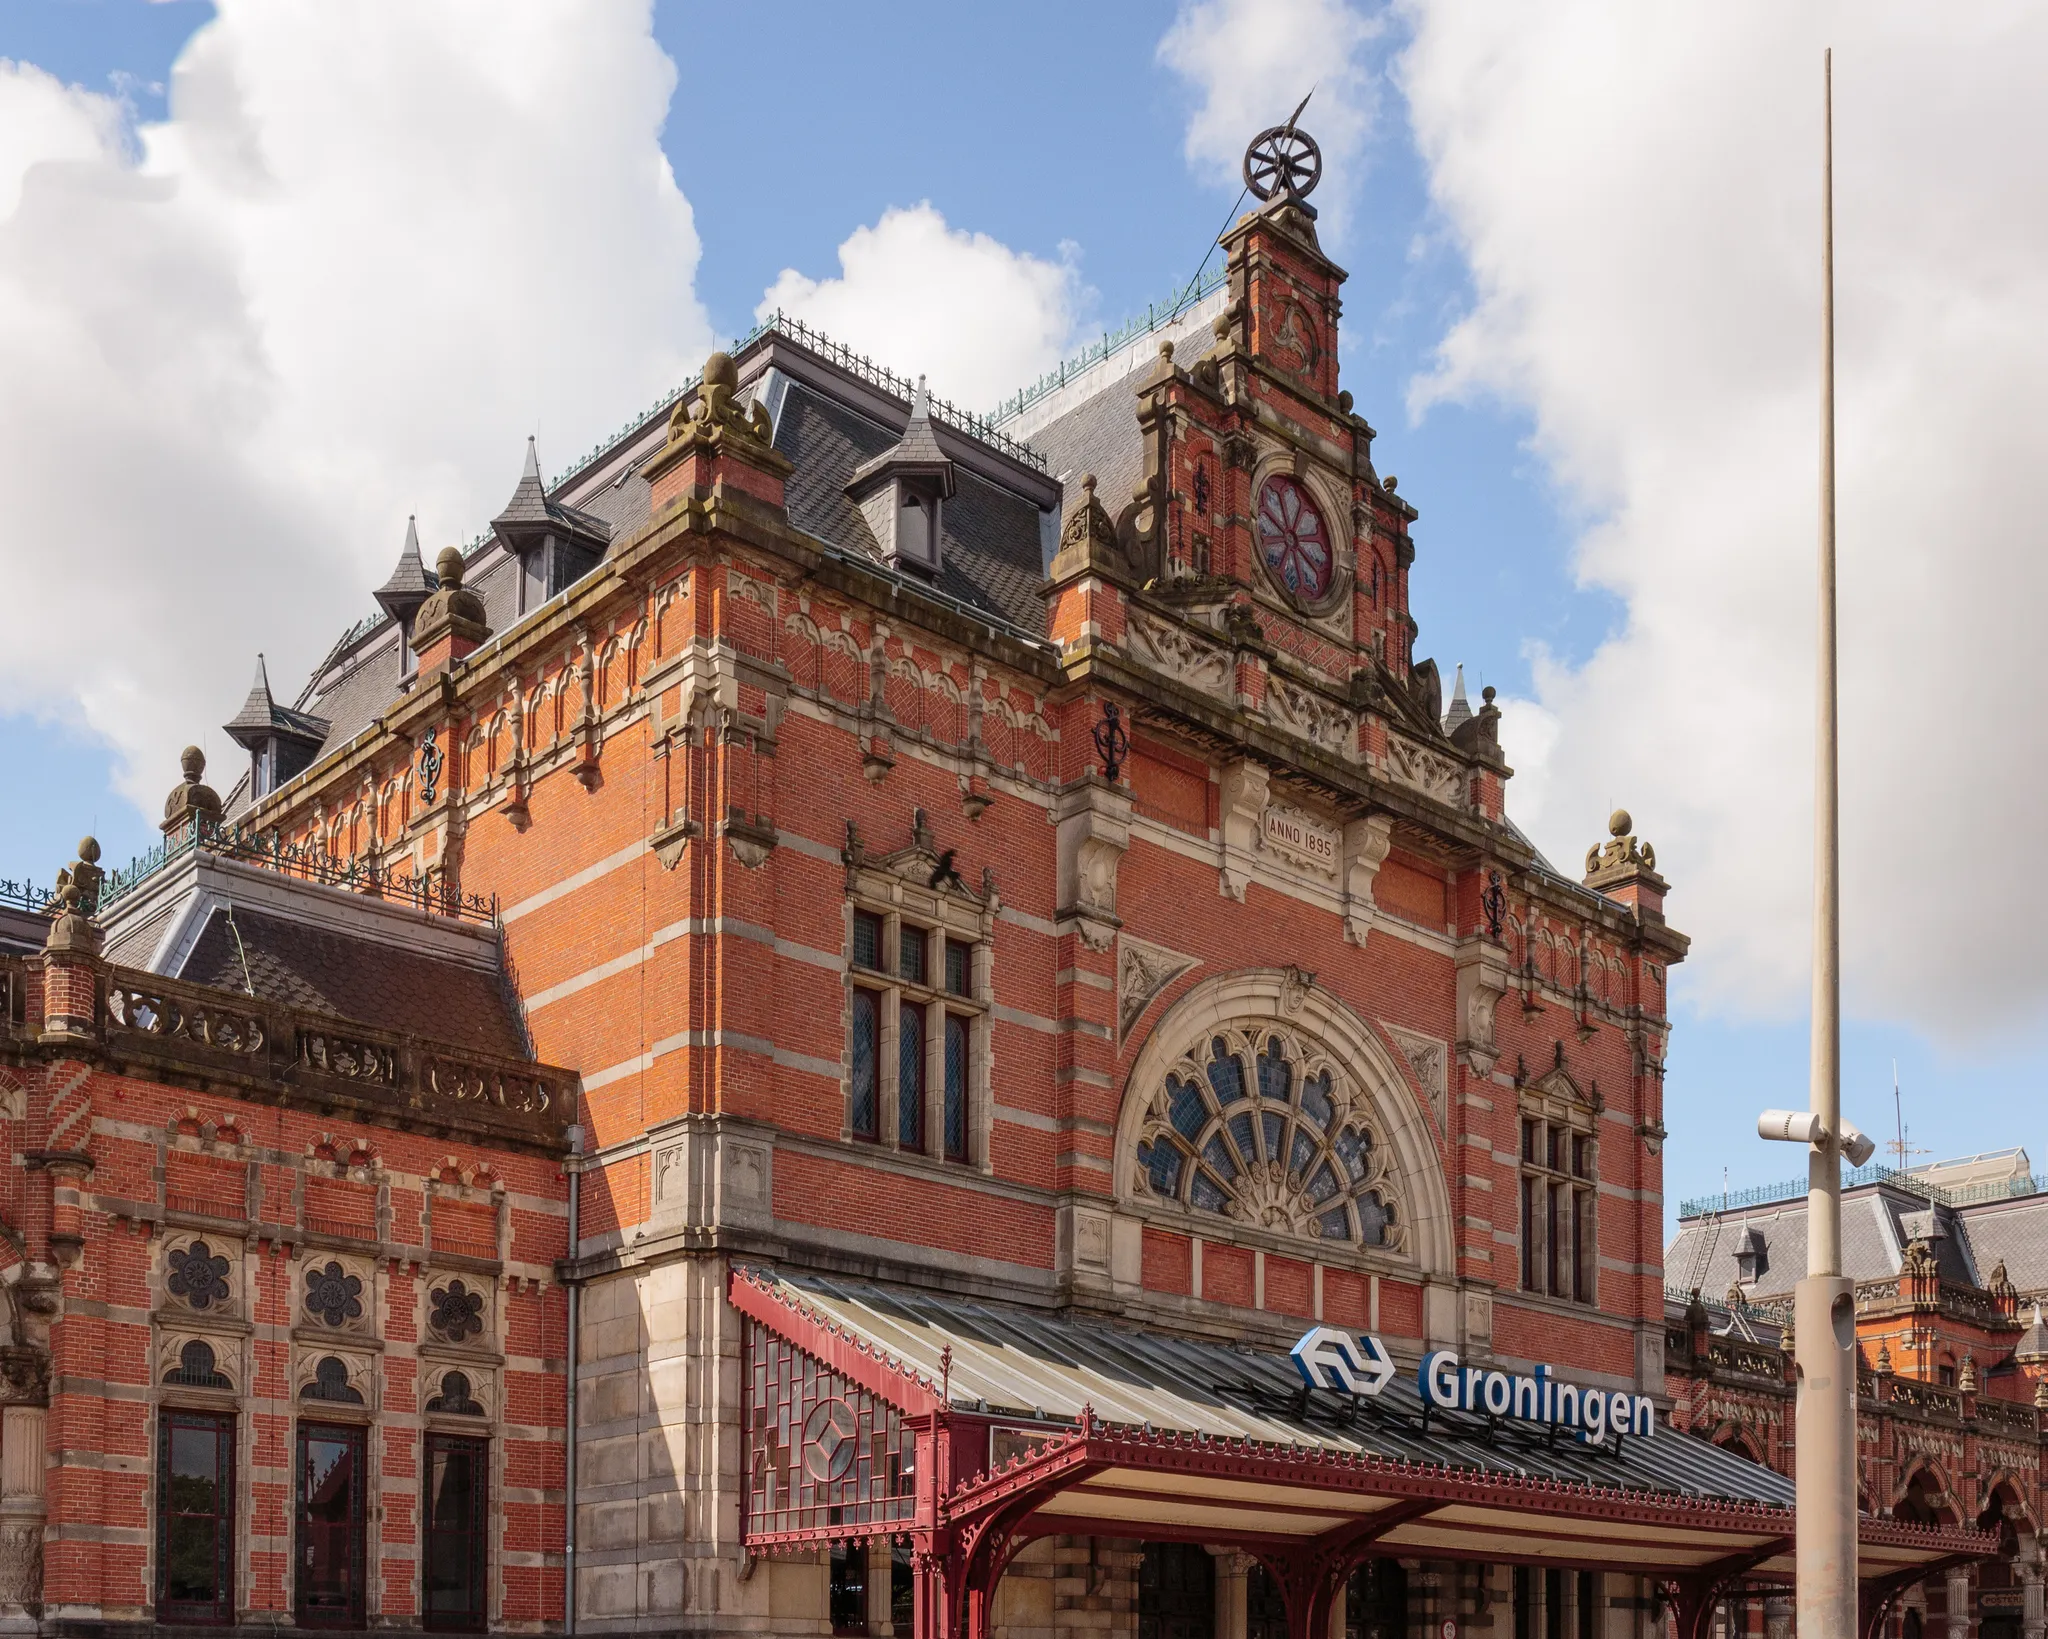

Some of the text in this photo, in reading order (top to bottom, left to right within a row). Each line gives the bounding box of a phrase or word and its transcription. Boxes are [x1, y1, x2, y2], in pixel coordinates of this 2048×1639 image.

[1270, 817, 1331, 856] ANNO 1895
[1419, 1350, 1655, 1445] Groningen
[1985, 1596, 2024, 1605] POSTERI
